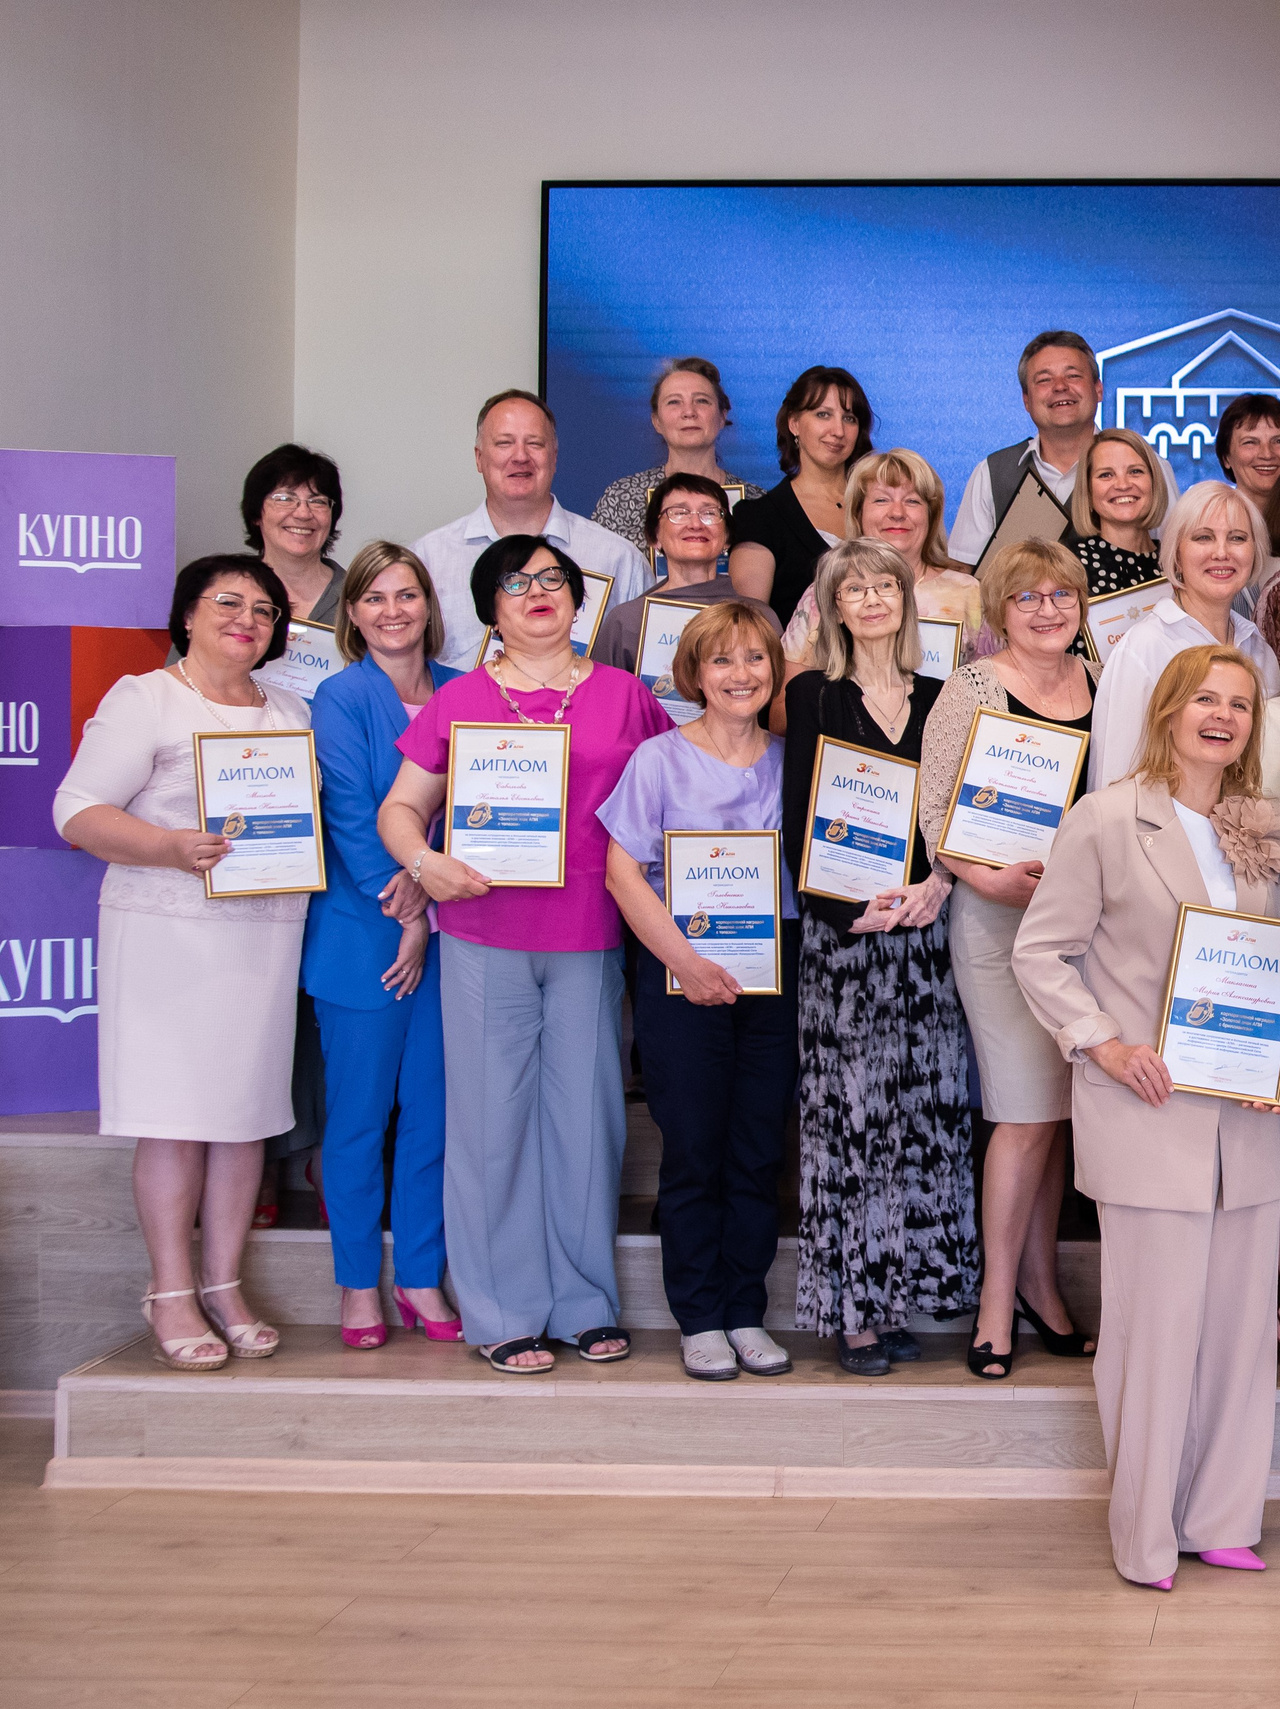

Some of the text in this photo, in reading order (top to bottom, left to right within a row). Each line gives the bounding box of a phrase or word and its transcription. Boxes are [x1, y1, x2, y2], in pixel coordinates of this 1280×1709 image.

[19, 513, 142, 559] КУПНО
[284, 648, 329, 670] ПЛОМ
[469, 757, 547, 773] ДИПЛОМ
[985, 745, 1060, 772] ДИПЛОМ
[216, 766, 294, 780] ДИПЛОМ
[832, 774, 899, 803] ДИПЛОМ
[685, 866, 759, 879] ДИПЛОМ
[0, 938, 99, 1002] УПН
[1195, 947, 1279, 973] ДИПЛОМ
[1220, 989, 1276, 1007] Александровна
